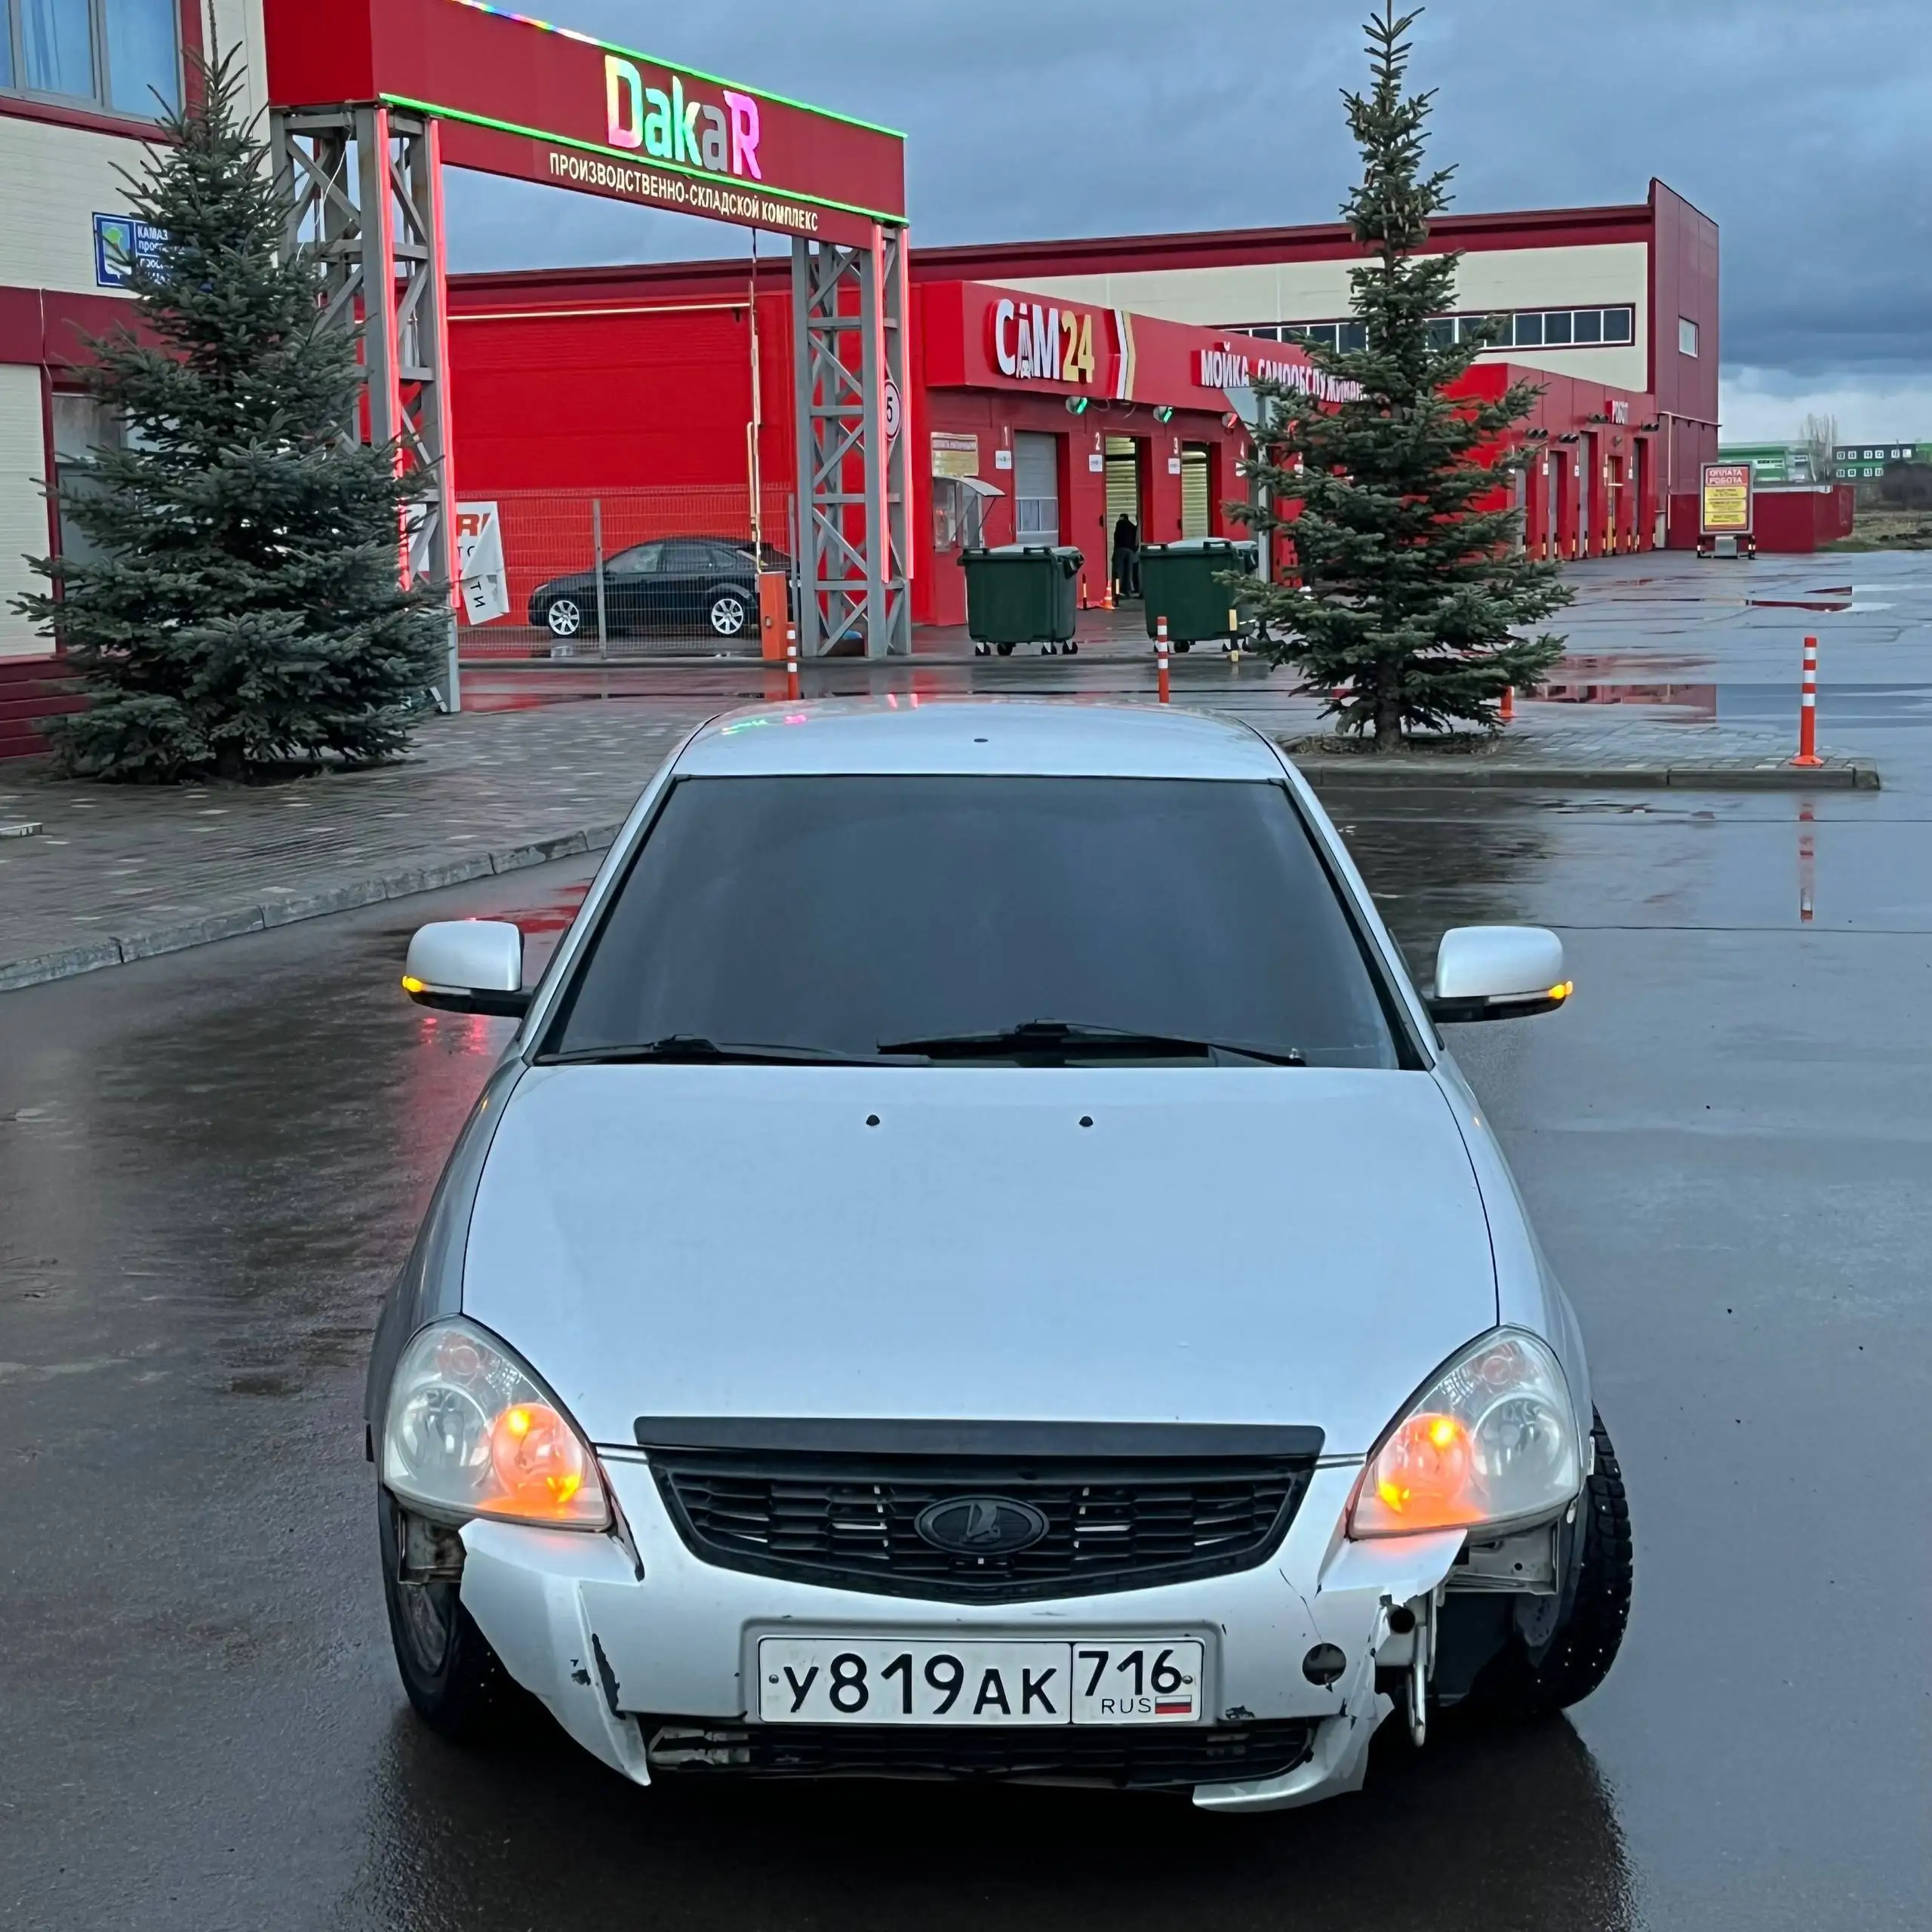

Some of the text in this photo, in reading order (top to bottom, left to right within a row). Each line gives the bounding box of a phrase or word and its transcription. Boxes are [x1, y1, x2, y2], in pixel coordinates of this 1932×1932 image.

[605, 54, 761, 180] DakaR
[549, 152, 818, 232] ПРОИЗВОДСТВЕННО-СКЛАДСКОЙ КОМПЛЕКС
[1201, 341, 1250, 388] МОЙКА
[886, 396, 894, 423] 5
[1004, 426, 1008, 447] 1
[1095, 432, 1100, 451] 2
[1174, 437, 1179, 454] 3
[783, 1649, 1182, 1715] У819АК 716
[1102, 1698, 1152, 1715] RUS
